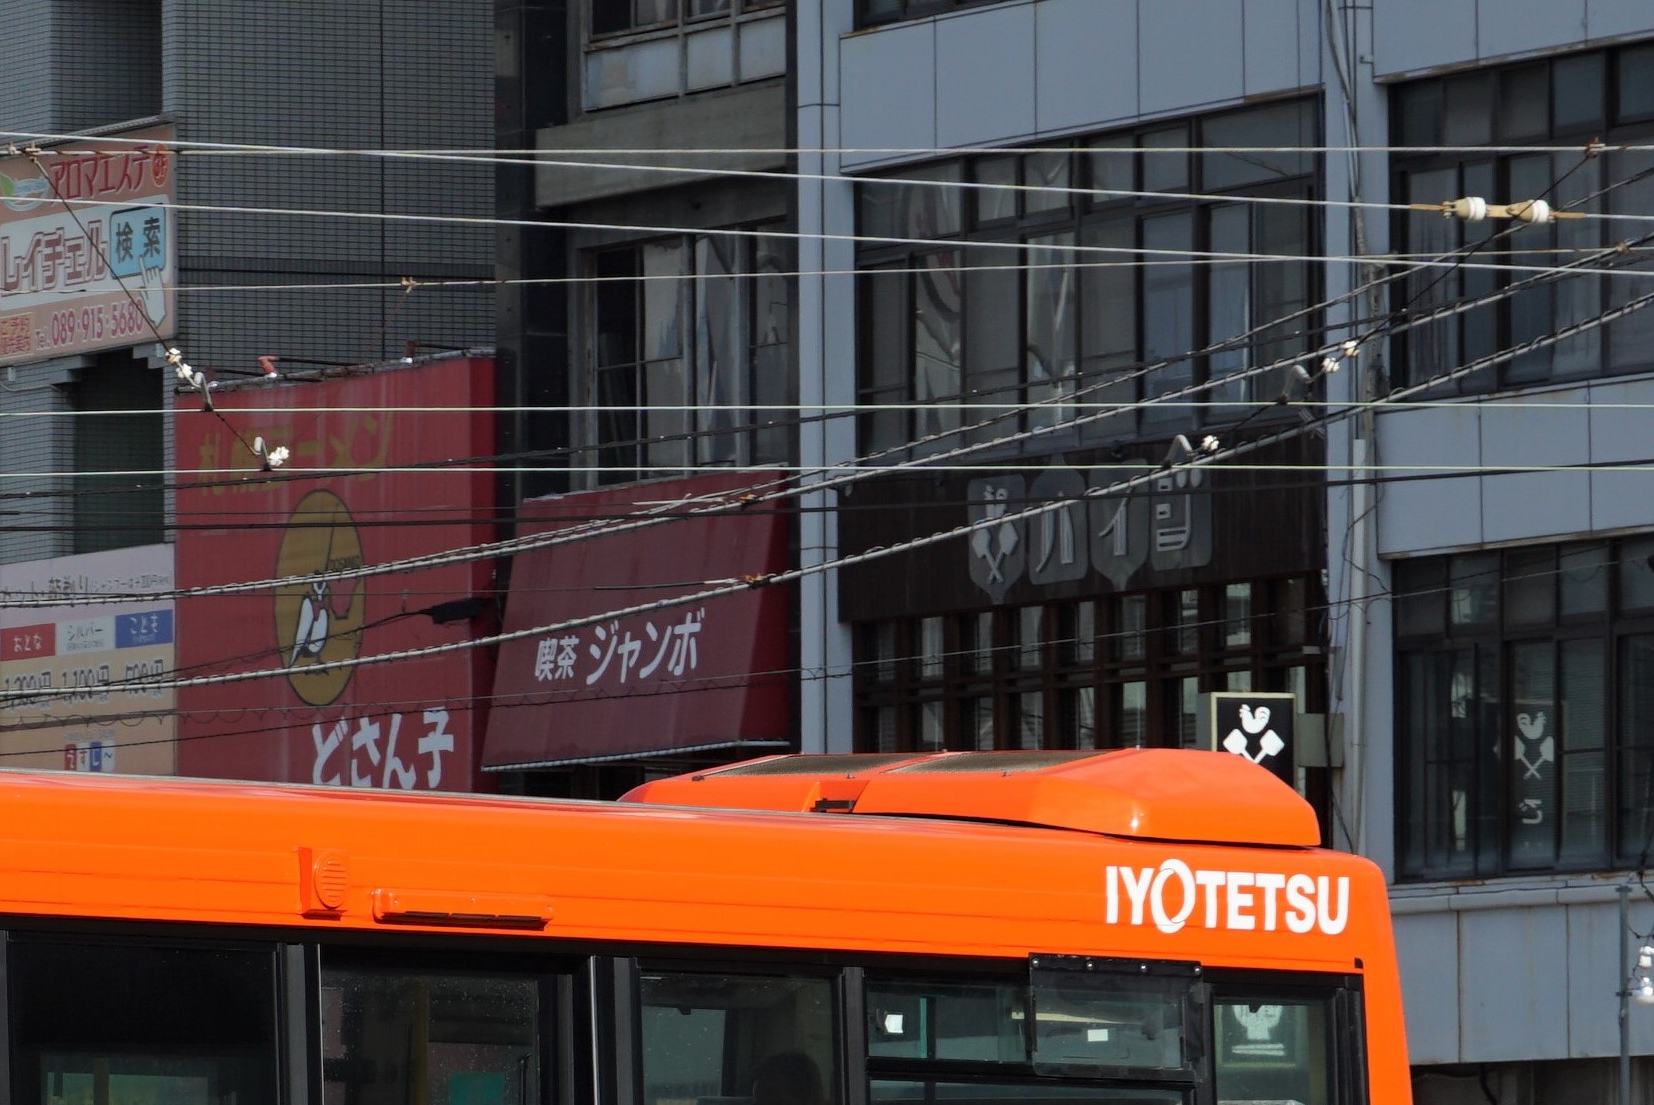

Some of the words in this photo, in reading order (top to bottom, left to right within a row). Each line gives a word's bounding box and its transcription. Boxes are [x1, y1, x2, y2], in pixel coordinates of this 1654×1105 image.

[49, 145, 152, 204] アロマエステ
[1, 220, 112, 297] レイチェル
[115, 216, 161, 265] 検索
[13, 632, 43, 652] おとな
[68, 621, 104, 641] シルバー
[534, 635, 580, 682] 喫茶
[586, 606, 706, 686] ジャンボ
[312, 705, 455, 789] どさん子
[1105, 858, 1350, 935] IYOTETSU
